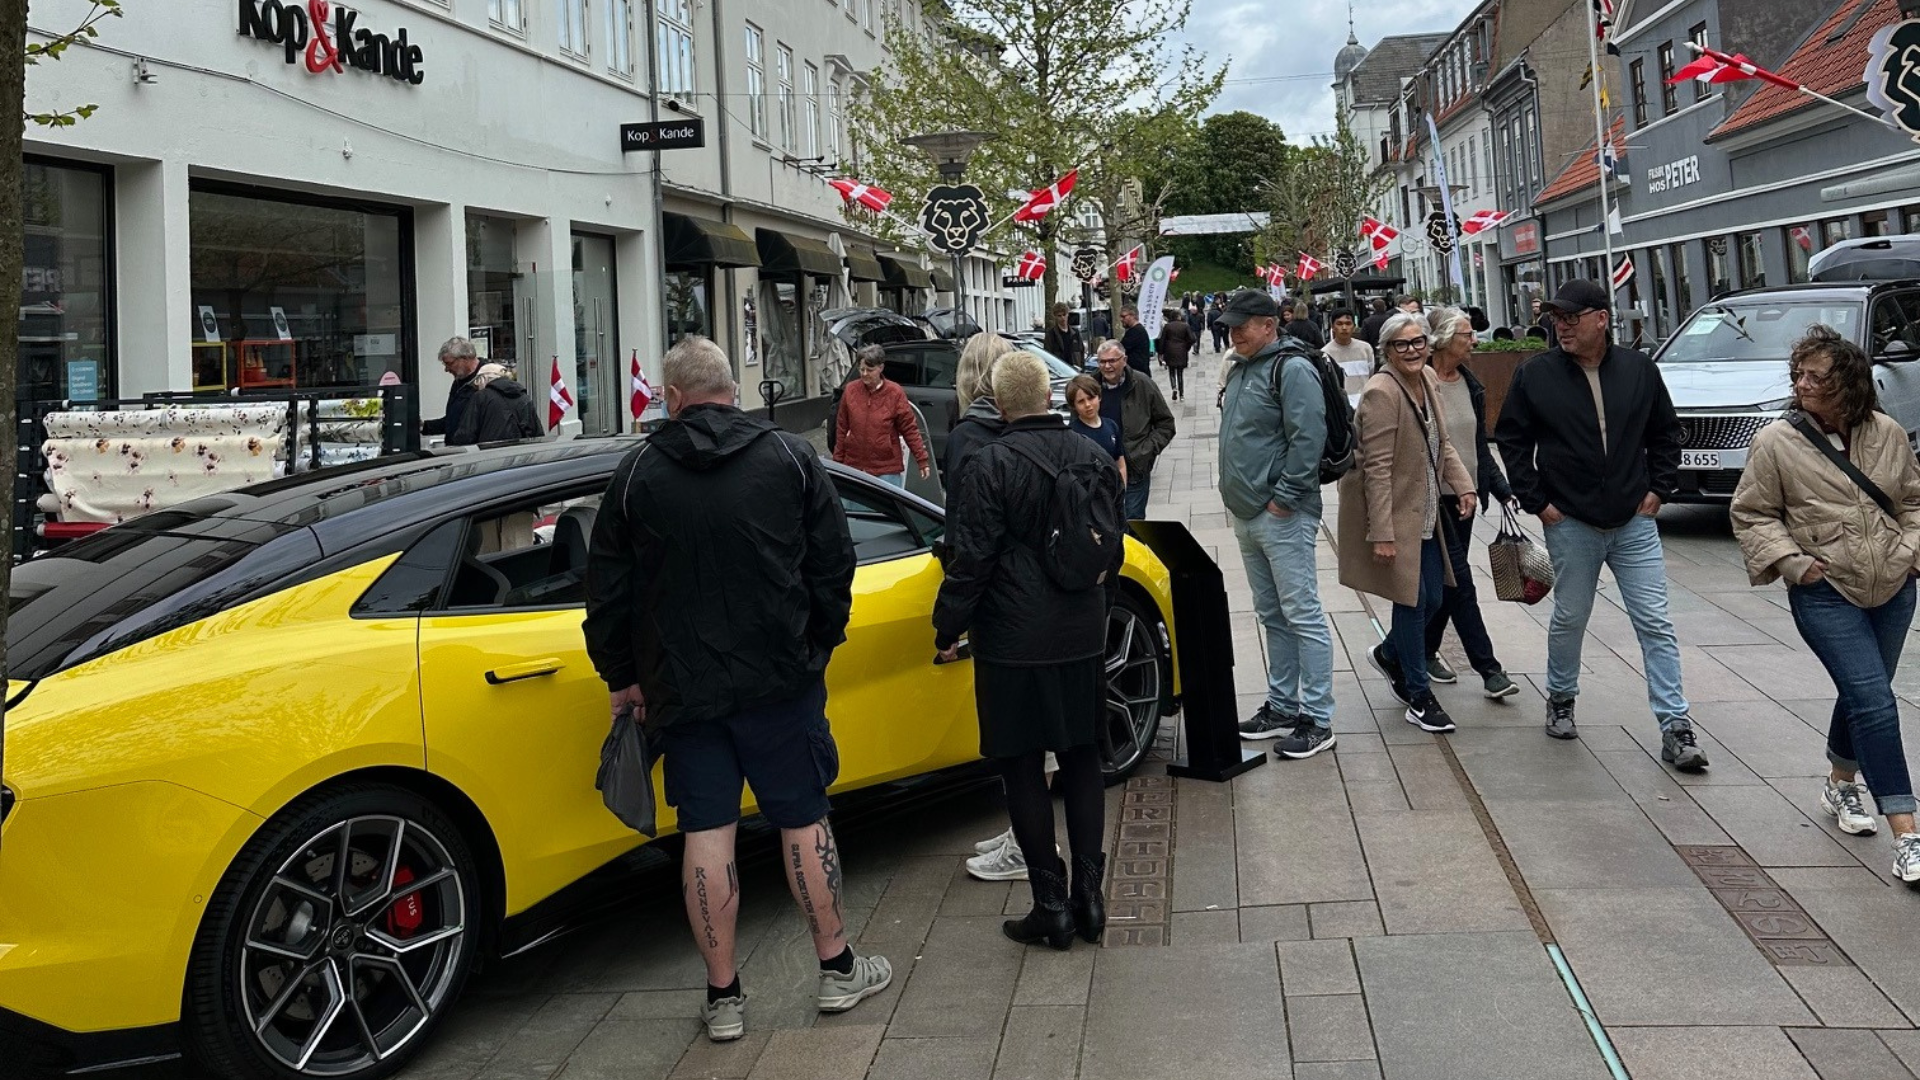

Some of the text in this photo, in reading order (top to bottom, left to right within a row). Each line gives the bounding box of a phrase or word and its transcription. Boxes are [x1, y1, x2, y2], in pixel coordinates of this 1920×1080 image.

[659, 126, 694, 139] Kande
[1649, 154, 1700, 194] HOS PETER
[1693, 453, 1718, 466] 655
